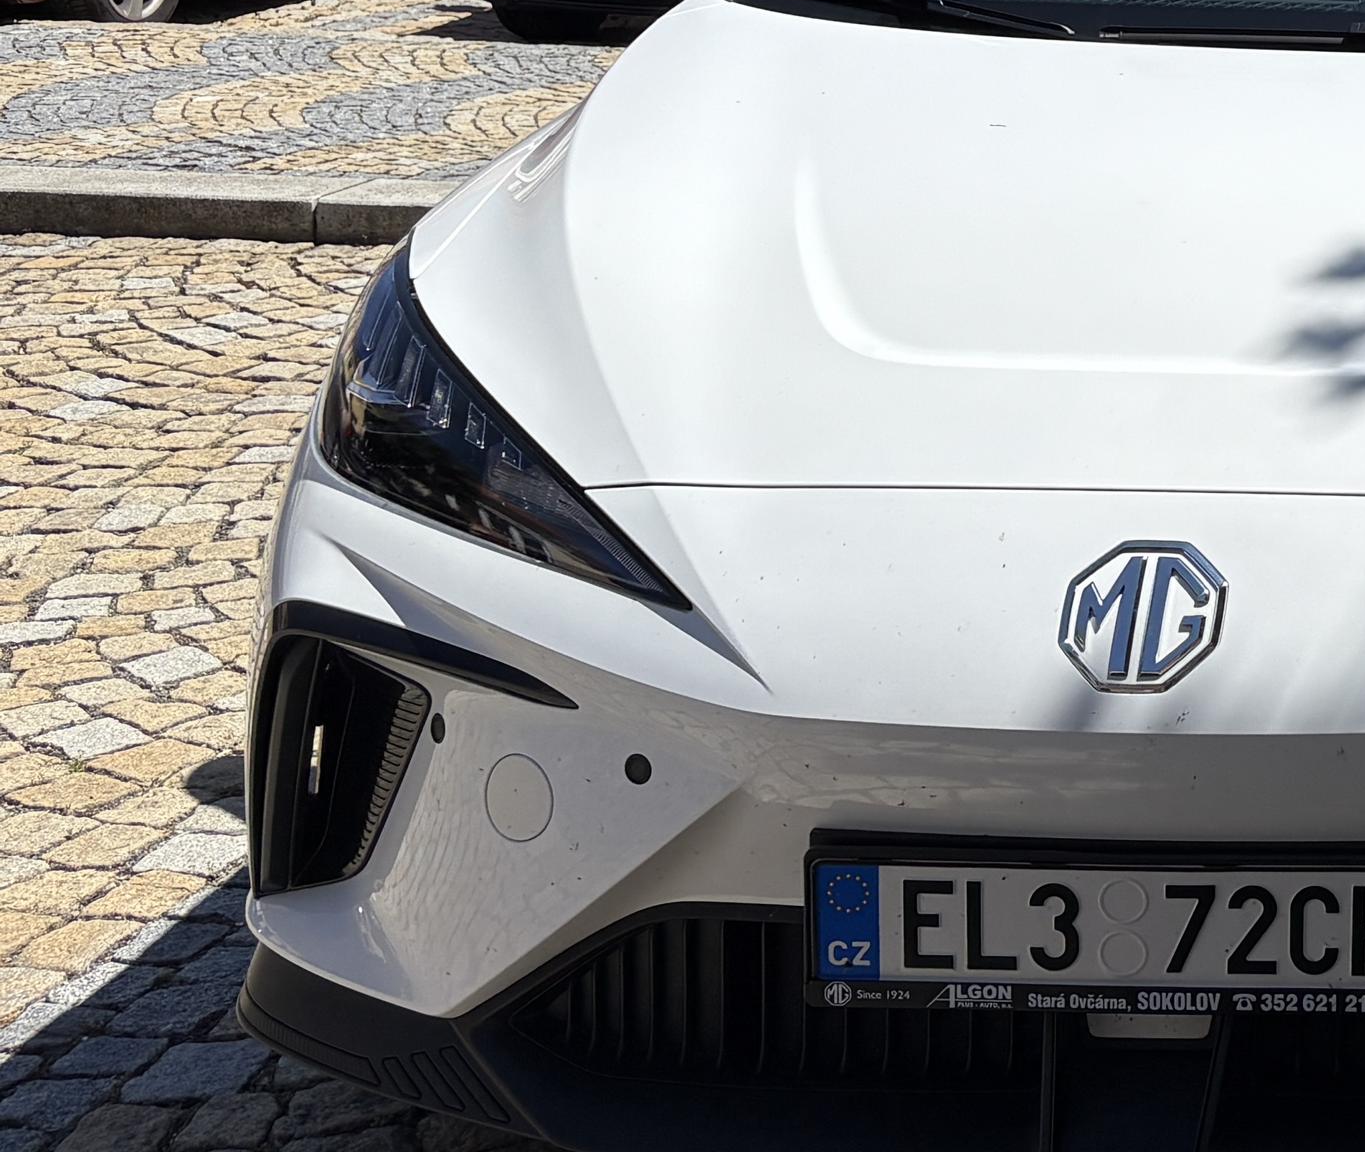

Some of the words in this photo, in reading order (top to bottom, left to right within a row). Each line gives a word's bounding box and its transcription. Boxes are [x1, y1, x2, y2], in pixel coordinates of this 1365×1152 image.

[1069, 551, 1213, 685] MG
[827, 942, 870, 967] CZ
[902, 880, 1079, 971] EL3
[825, 982, 851, 1006] MG
[856, 989, 882, 1000] Since
[887, 990, 910, 1000] 1924
[926, 984, 1013, 1008] ALGON
[1028, 993, 1065, 1008] Stará
[1069, 992, 1131, 1011] Ovčárna,
[1137, 991, 1220, 1011] SOKOLOV
[1260, 994, 1298, 1012] 352
[1303, 995, 1336, 1012] 621
